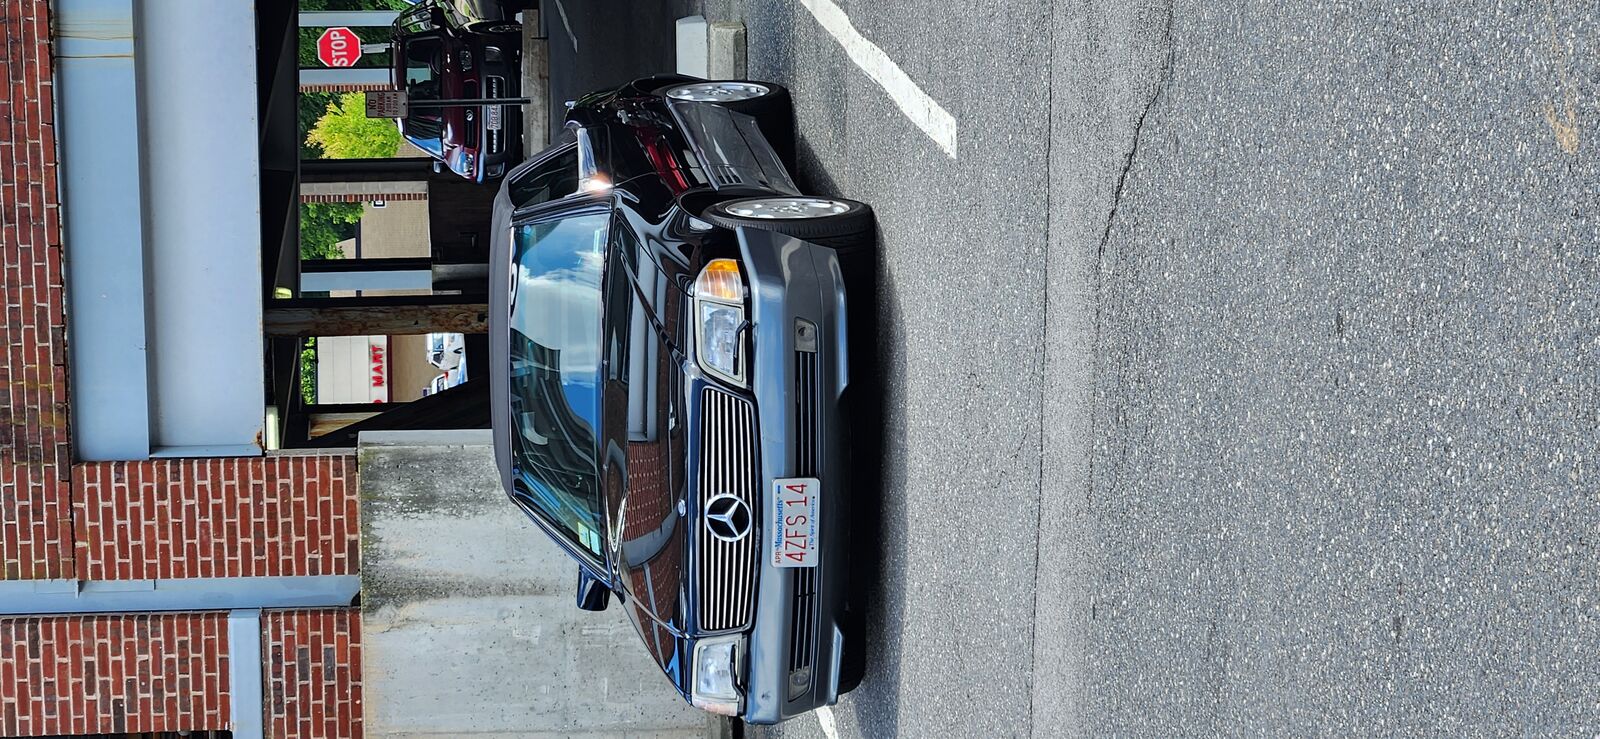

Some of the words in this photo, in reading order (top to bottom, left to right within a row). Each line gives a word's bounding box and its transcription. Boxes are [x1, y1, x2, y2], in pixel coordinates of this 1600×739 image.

[330, 31, 348, 66] STOP
[368, 99, 376, 109] NO
[377, 92, 385, 116] PARKING
[371, 345, 384, 387] MART
[785, 483, 807, 507] 14
[775, 499, 783, 548] Massachusetts
[784, 515, 807, 562] 4ZFS
